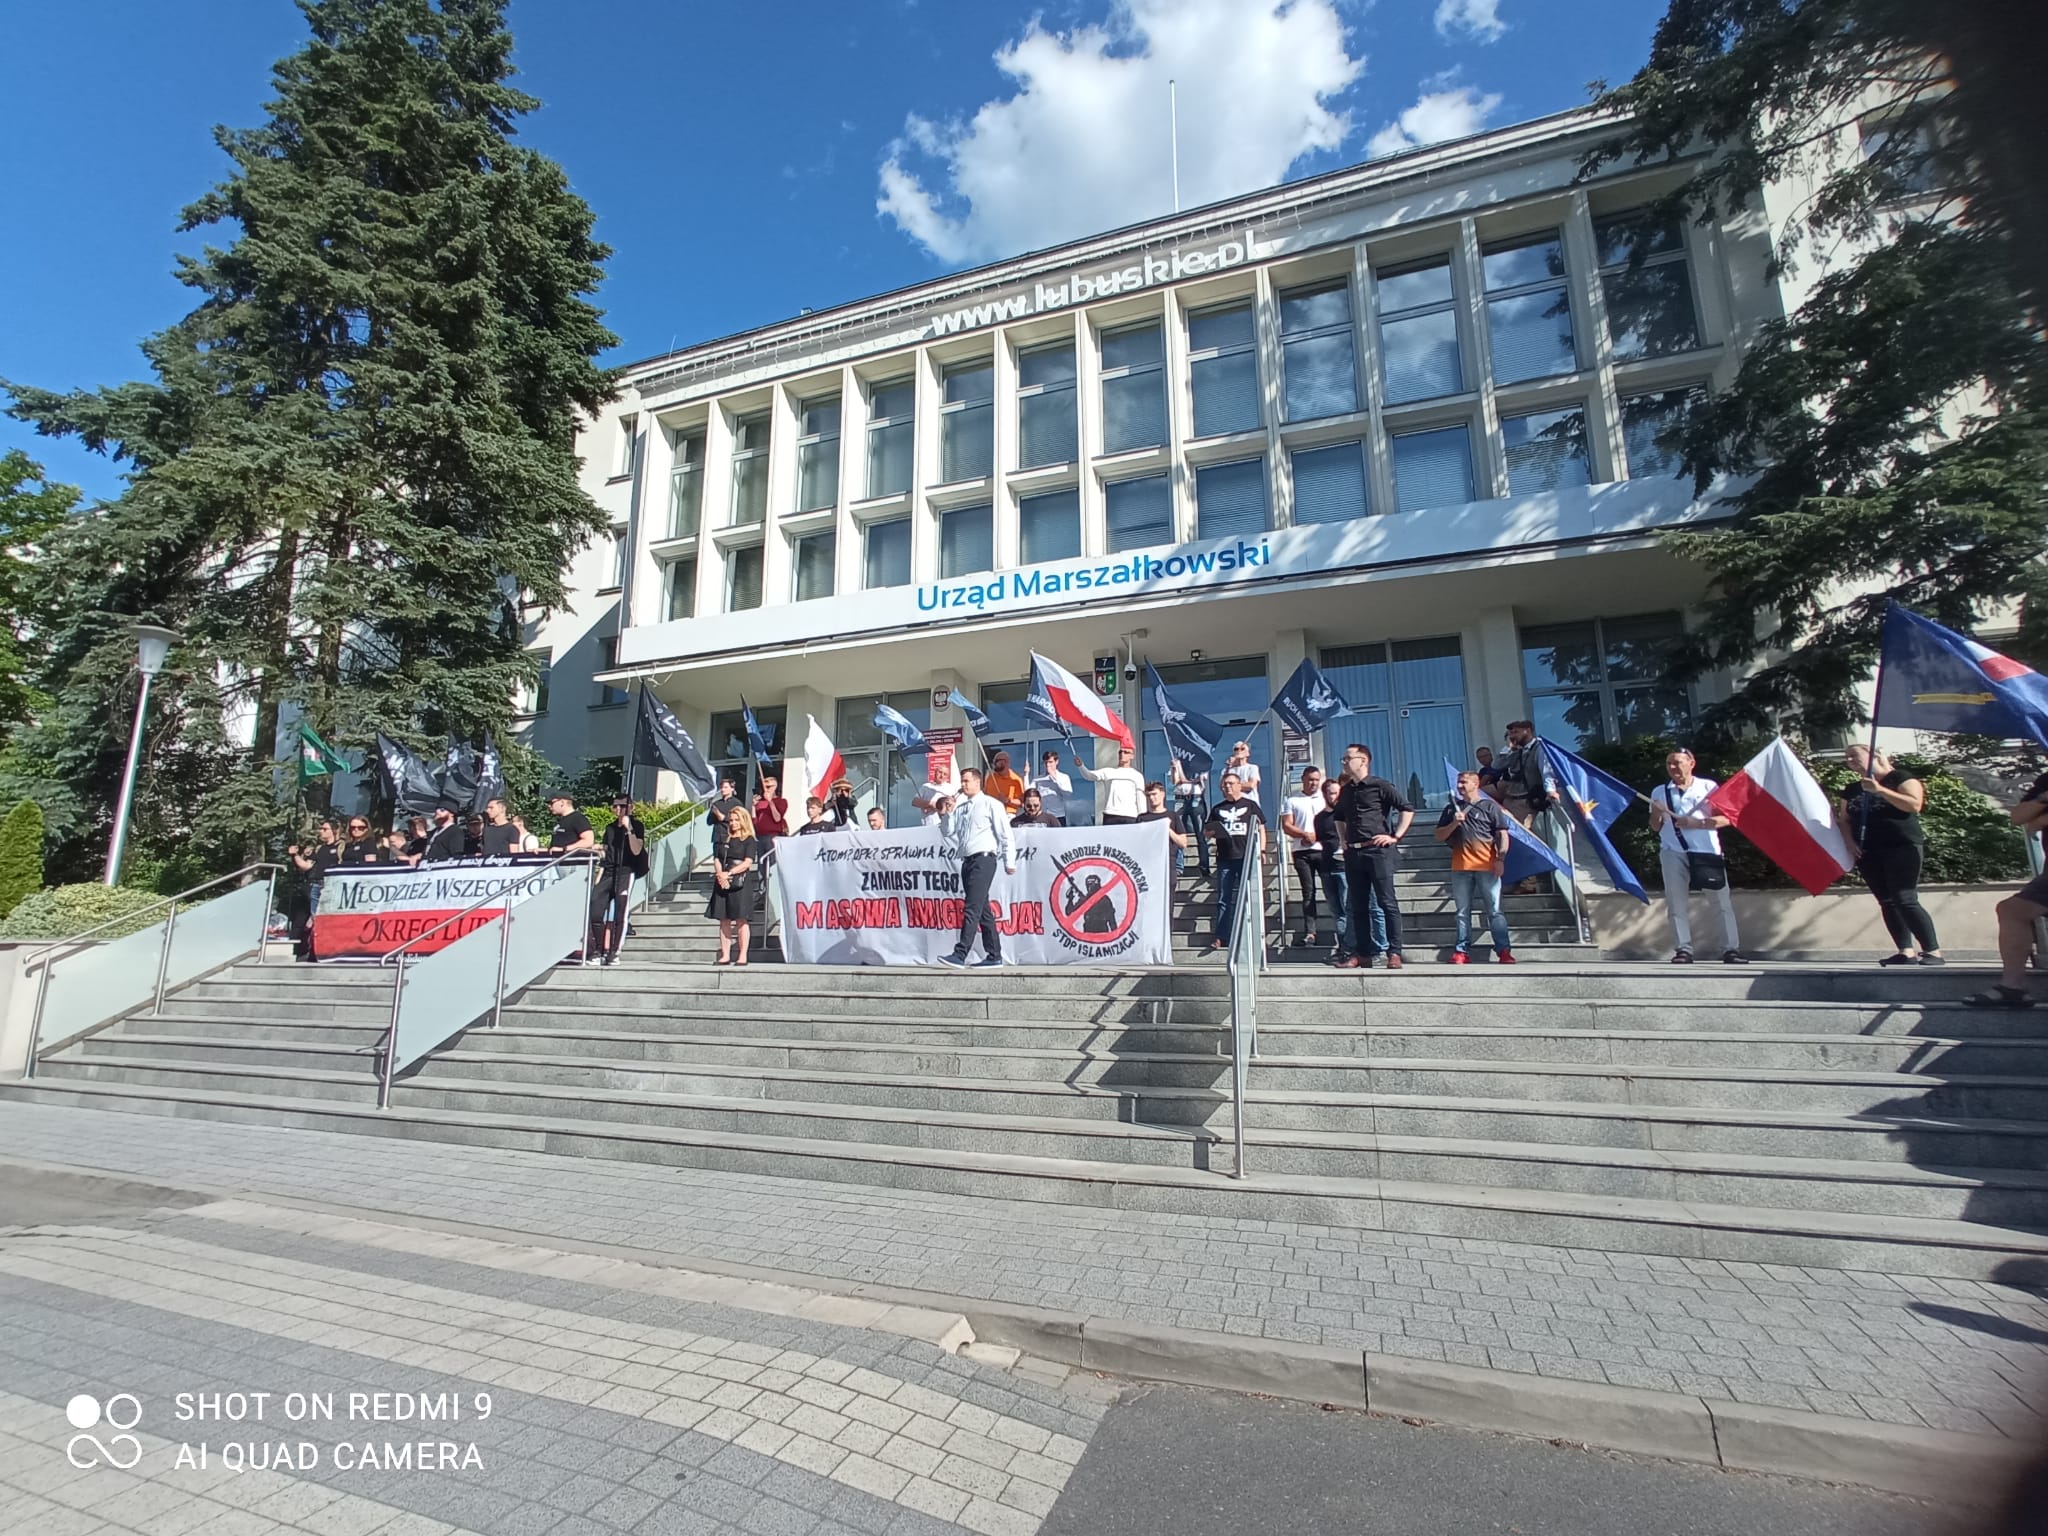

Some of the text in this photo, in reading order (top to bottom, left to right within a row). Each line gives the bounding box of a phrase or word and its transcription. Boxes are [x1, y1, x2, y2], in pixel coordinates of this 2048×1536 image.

[931, 230, 1255, 335] www.lubuskie.pl
[917, 538, 1271, 611] Urząd Marszałkowski
[861, 871, 920, 892] ZAMIAST
[1060, 844, 1149, 894] MŁODZIEŻ WSZECHPOLSKA
[337, 878, 432, 909] MŁODZIEŻ
[796, 897, 902, 930] MASOWA
[1052, 928, 1140, 958] STOP ISLAMIZACJI
